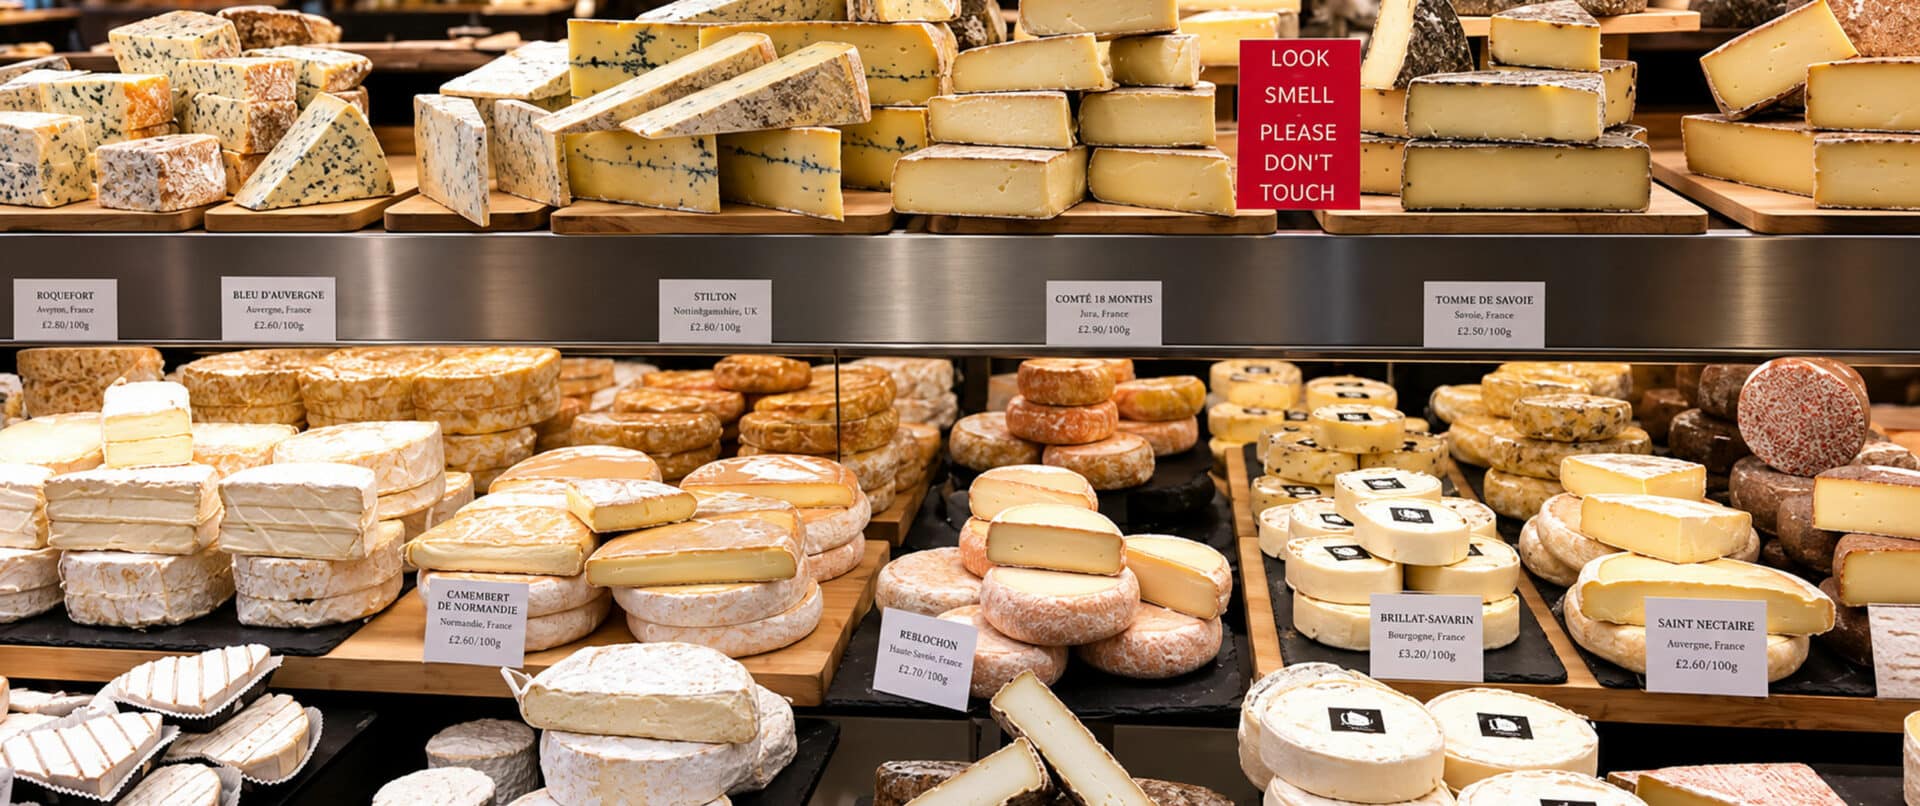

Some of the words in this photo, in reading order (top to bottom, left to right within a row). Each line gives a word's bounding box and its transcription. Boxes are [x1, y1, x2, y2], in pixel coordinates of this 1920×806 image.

[1271, 48, 1330, 68] LOOK
[1264, 85, 1335, 104] SMELL
[1260, 123, 1337, 142] PLEASE
[1264, 153, 1334, 172] DON'T
[1259, 183, 1335, 202] TOUCH
[36, 291, 95, 302] ROQUEFORT
[233, 290, 259, 300] BLEU
[261, 290, 325, 300] D'AUVERGNE
[694, 291, 737, 302] STILTON
[1055, 292, 1092, 304] COMTÉ
[1095, 295, 1106, 304] 18
[1108, 295, 1153, 304] MONTHS
[1435, 295, 1476, 305] TOMME
[1479, 295, 1494, 305] DE
[1496, 295, 1534, 305] SAVOIE
[70, 305, 95, 314] France
[246, 305, 285, 316] Auvergne,
[286, 305, 312, 314] France
[745, 306, 758, 316] UK
[1080, 309, 1100, 319] Jura,
[1102, 309, 1129, 318] France
[1486, 311, 1515, 319] France
[254, 321, 305, 332] £2.60/100g
[1078, 325, 1131, 337] £2.90/100g
[1457, 327, 1512, 338] £2.50/100g
[446, 590, 510, 603] CAMEMBERT
[437, 601, 452, 611] DE
[453, 603, 518, 615] NORMANDIE
[439, 618, 486, 629] Normandie,
[487, 621, 513, 631] France
[1380, 613, 1474, 625] BRILLAT-SAVARIN
[1657, 618, 1694, 629] SAINT
[1696, 620, 1755, 632] NECTAIRE
[448, 635, 502, 649] £2.60/100g
[899, 630, 959, 651] REBLOCHON
[1388, 631, 1435, 642] Bourgogne,
[1437, 632, 1466, 642] France
[1667, 639, 1713, 651] Auvergne,
[1714, 641, 1745, 651] France
[938, 655, 963, 669] France
[1398, 649, 1457, 663] £3.20/100g
[1675, 659, 1738, 674] £2.60/100g
[897, 664, 949, 686] £2.70/100g
